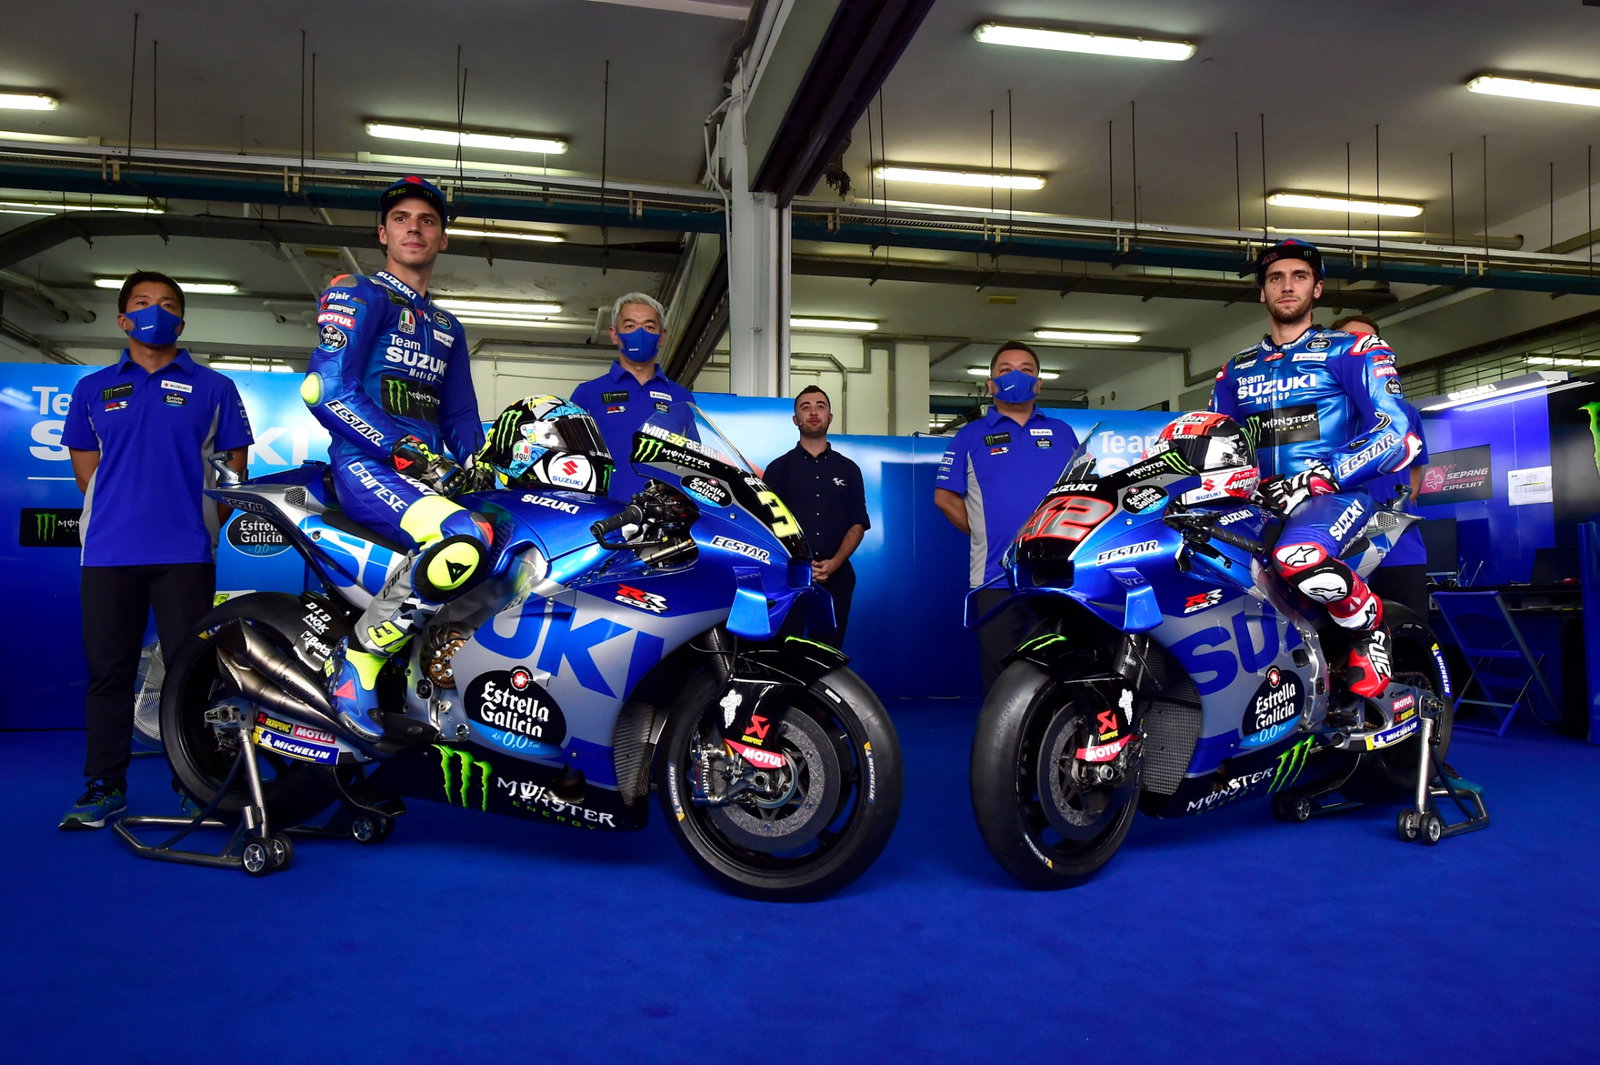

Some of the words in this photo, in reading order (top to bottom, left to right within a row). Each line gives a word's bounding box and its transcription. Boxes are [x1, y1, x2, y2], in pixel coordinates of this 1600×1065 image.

[376, 271, 417, 300] SUZUKI
[318, 314, 353, 327] MOTUL
[389, 334, 421, 350] Team
[385, 346, 448, 377] SUZUK
[1375, 366, 1398, 377] MOTU
[408, 368, 437, 382] MotoGP
[1236, 374, 1265, 387] Team
[1237, 373, 1317, 400] SUZUKI
[32, 386, 73, 416] Te
[1256, 392, 1290, 405] MotoGP
[325, 399, 384, 447] ECSTAR
[1262, 413, 1317, 429] MONSTER
[661, 448, 711, 469] MONSTER
[1337, 432, 1400, 479] ECSTAR
[1126, 461, 1167, 478] MONSTER
[1446, 468, 1489, 480] SEPANG
[347, 461, 409, 513] DAINESE
[552, 475, 584, 487] SUZUKI
[692, 477, 726, 498] Estrella
[1442, 481, 1485, 491] CIRCUIT
[689, 482, 721, 503] Galicia
[1195, 491, 1222, 501] SUZUKI
[521, 494, 580, 516] SUZUKI
[1218, 509, 1254, 526] SUZUKI
[1329, 499, 1365, 541] SUZUKI
[240, 531, 283, 544] Galicia
[710, 535, 770, 565] ECSTAR
[1096, 540, 1159, 566] ECSTAR
[306, 613, 330, 633] NGK
[307, 635, 332, 657] Beta
[1436, 656, 1451, 693] MICHELIN
[481, 680, 549, 722] Estrella
[1255, 683, 1296, 714] Estrella
[1394, 696, 1413, 709] MOTUL
[481, 701, 543, 738] Galicia
[1256, 702, 1295, 730] Galicia
[295, 727, 335, 744] MOTUL
[1386, 721, 1418, 742] MICHELIN
[273, 739, 331, 760] MICHELIN
[742, 748, 783, 768] MOTUL
[1085, 742, 1122, 761] MOTUL
[868, 758, 876, 801] MICHELIN
[1186, 767, 1274, 812] MONSTER
[497, 776, 617, 828] MONSTER
[512, 801, 596, 831] ENERGY
